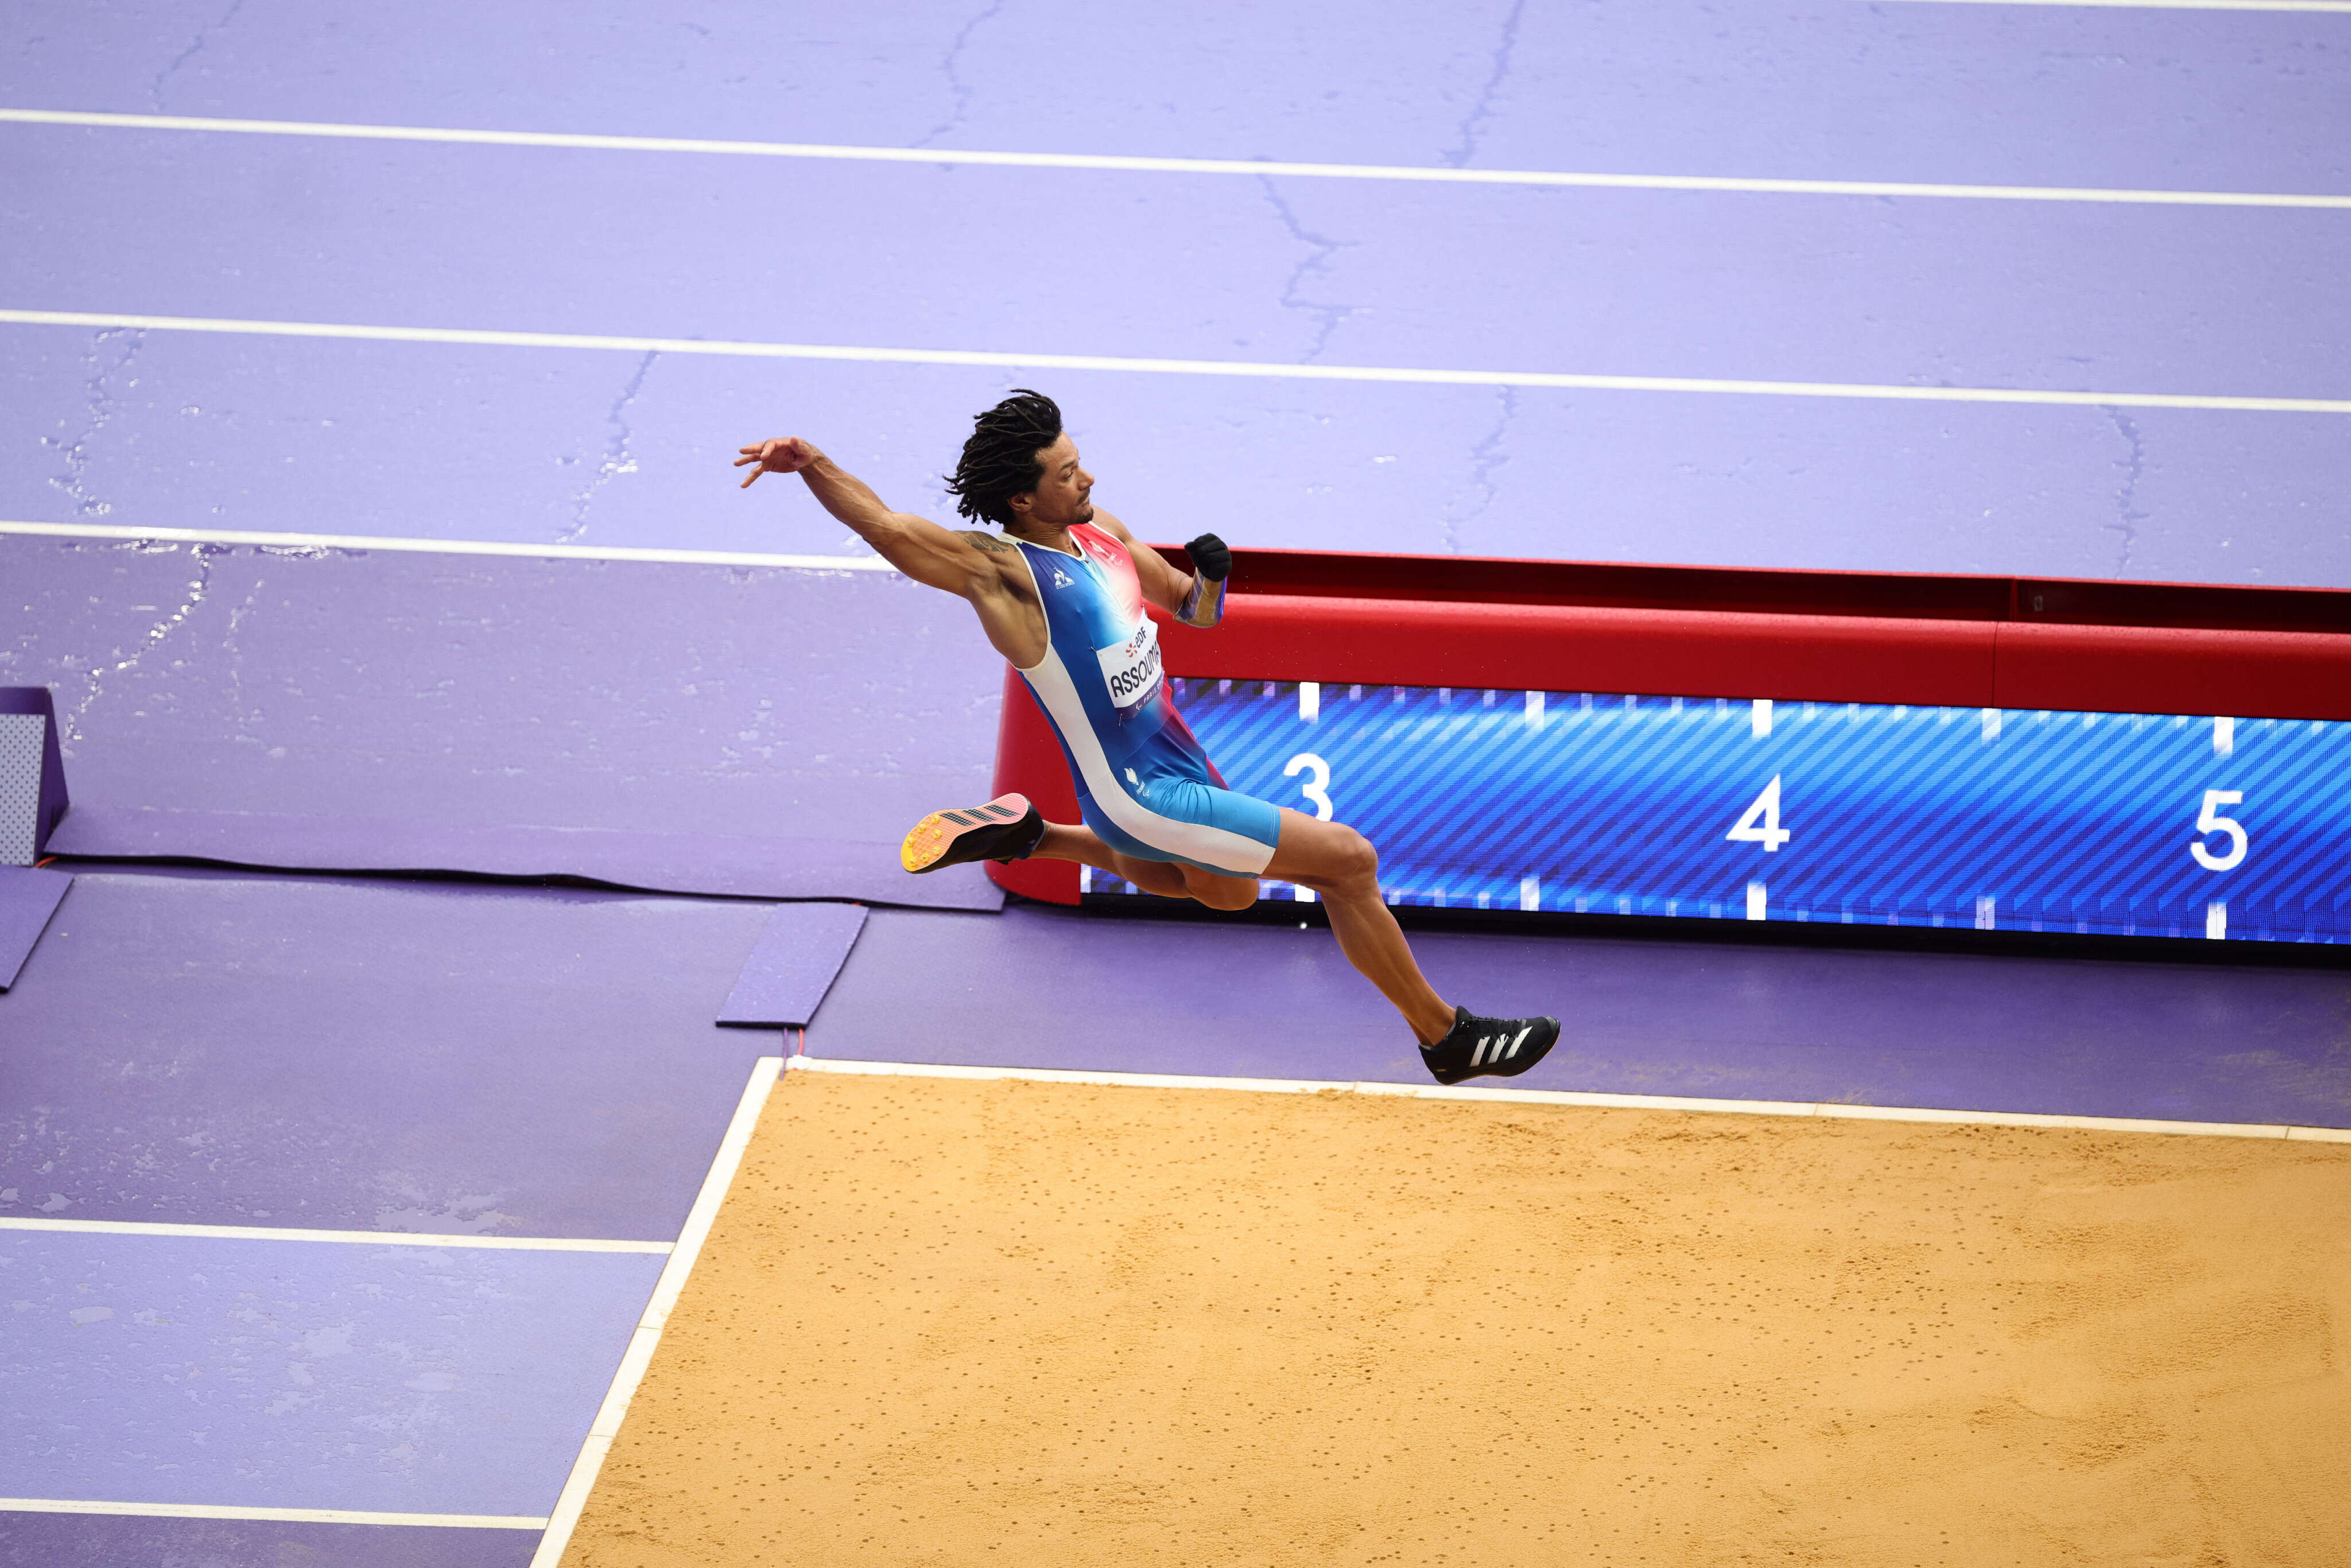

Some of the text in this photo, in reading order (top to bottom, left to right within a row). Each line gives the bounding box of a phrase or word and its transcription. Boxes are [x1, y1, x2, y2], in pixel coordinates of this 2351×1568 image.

[1111, 641, 1159, 697] ASSOUMA
[1143, 687, 1157, 704] PARIS
[1283, 752, 1333, 822] 3
[1725, 774, 1790, 852] 4
[2191, 789, 2248, 872] 5
